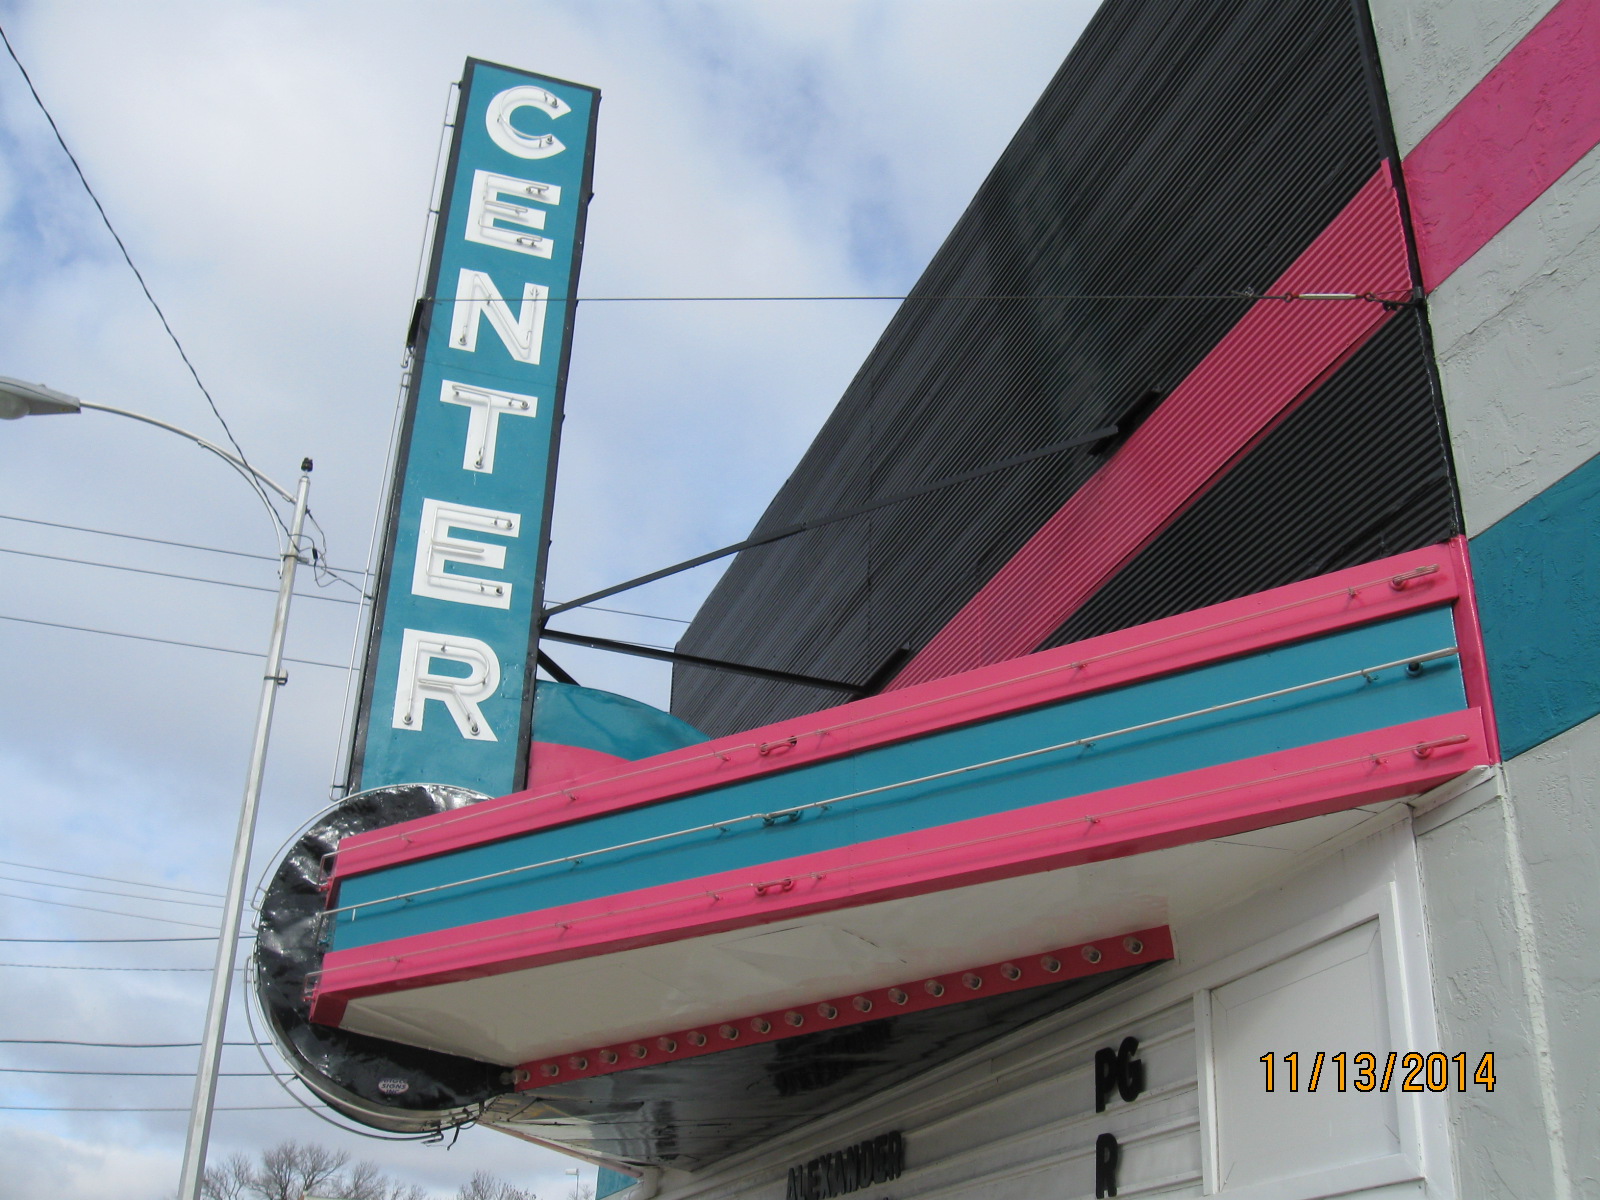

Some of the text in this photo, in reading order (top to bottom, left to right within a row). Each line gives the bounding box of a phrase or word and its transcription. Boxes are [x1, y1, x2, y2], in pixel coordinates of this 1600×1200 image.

[391, 85, 572, 742] CENTER
[1095, 1036, 1142, 1113] PG
[786, 1130, 902, 1200] ALEXANDER
[1096, 1133, 1118, 1199] R
